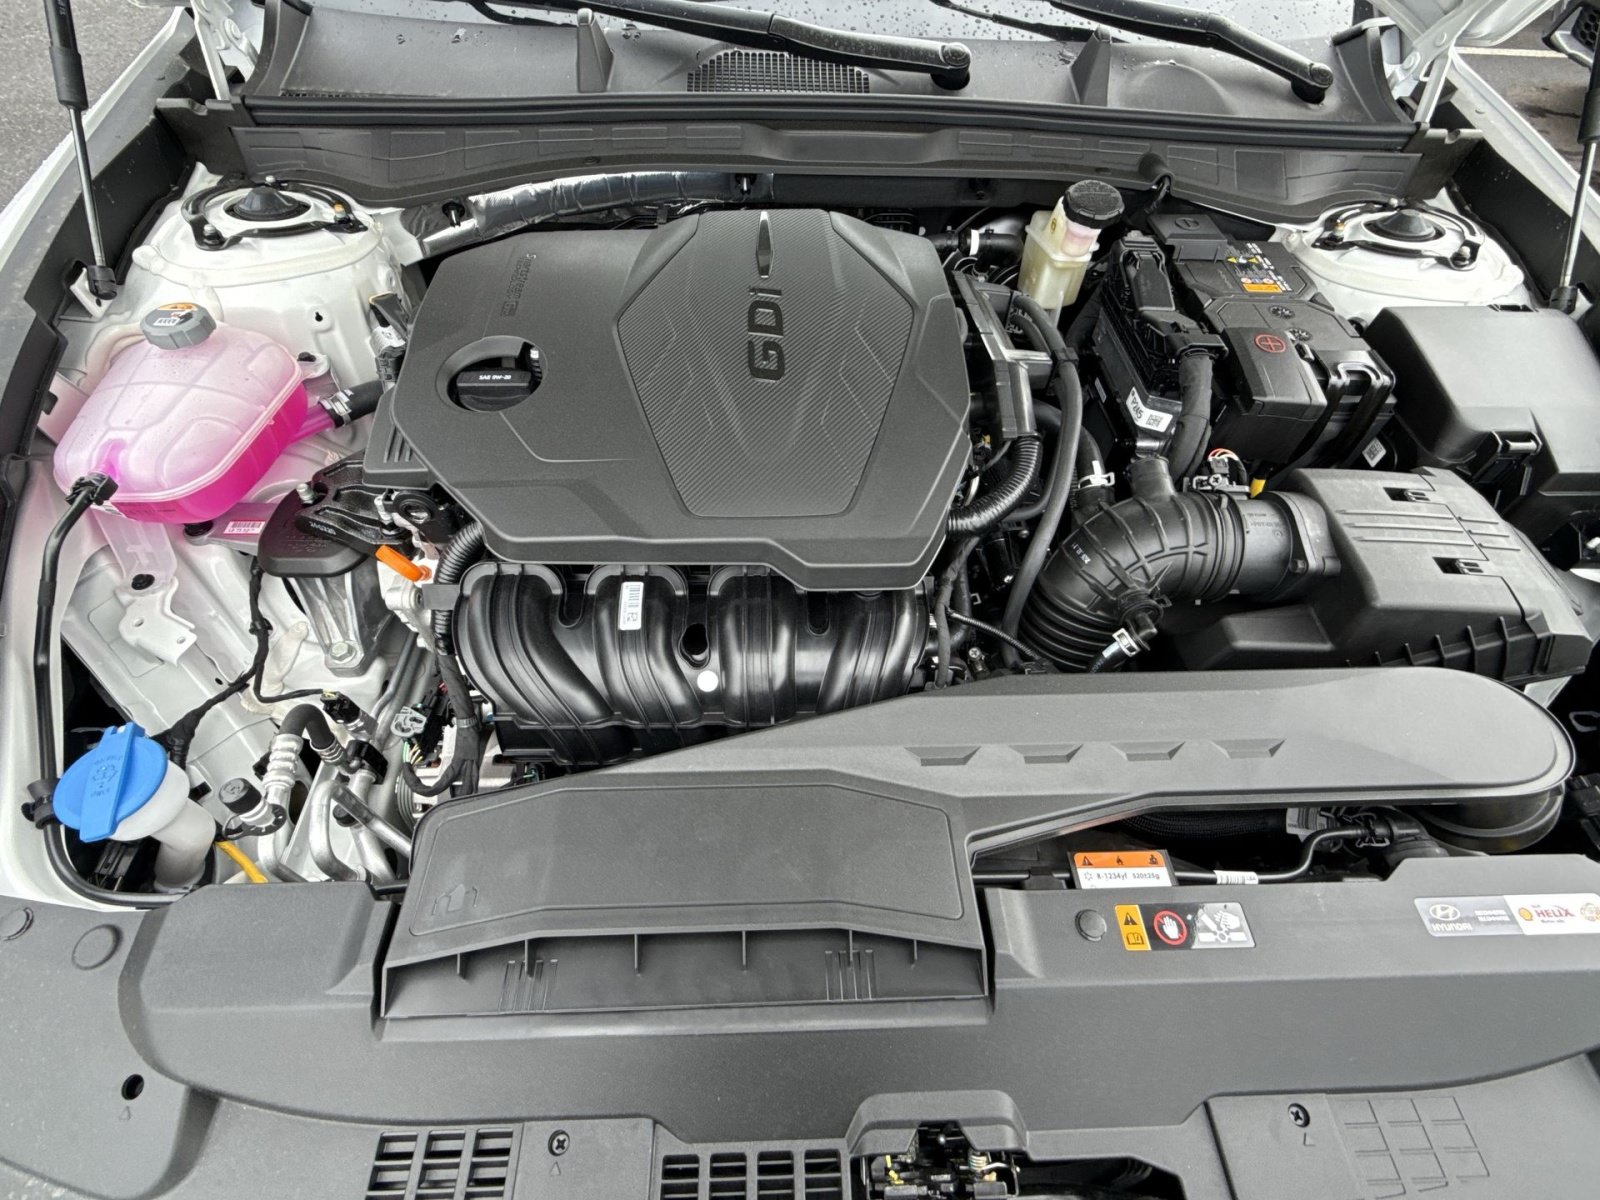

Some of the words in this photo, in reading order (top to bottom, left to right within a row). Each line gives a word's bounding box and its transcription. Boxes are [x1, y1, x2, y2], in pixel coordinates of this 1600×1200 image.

[747, 286, 785, 381] GDi
[1534, 904, 1576, 918] HELIX
[1431, 922, 1473, 931] HYUNDAI
